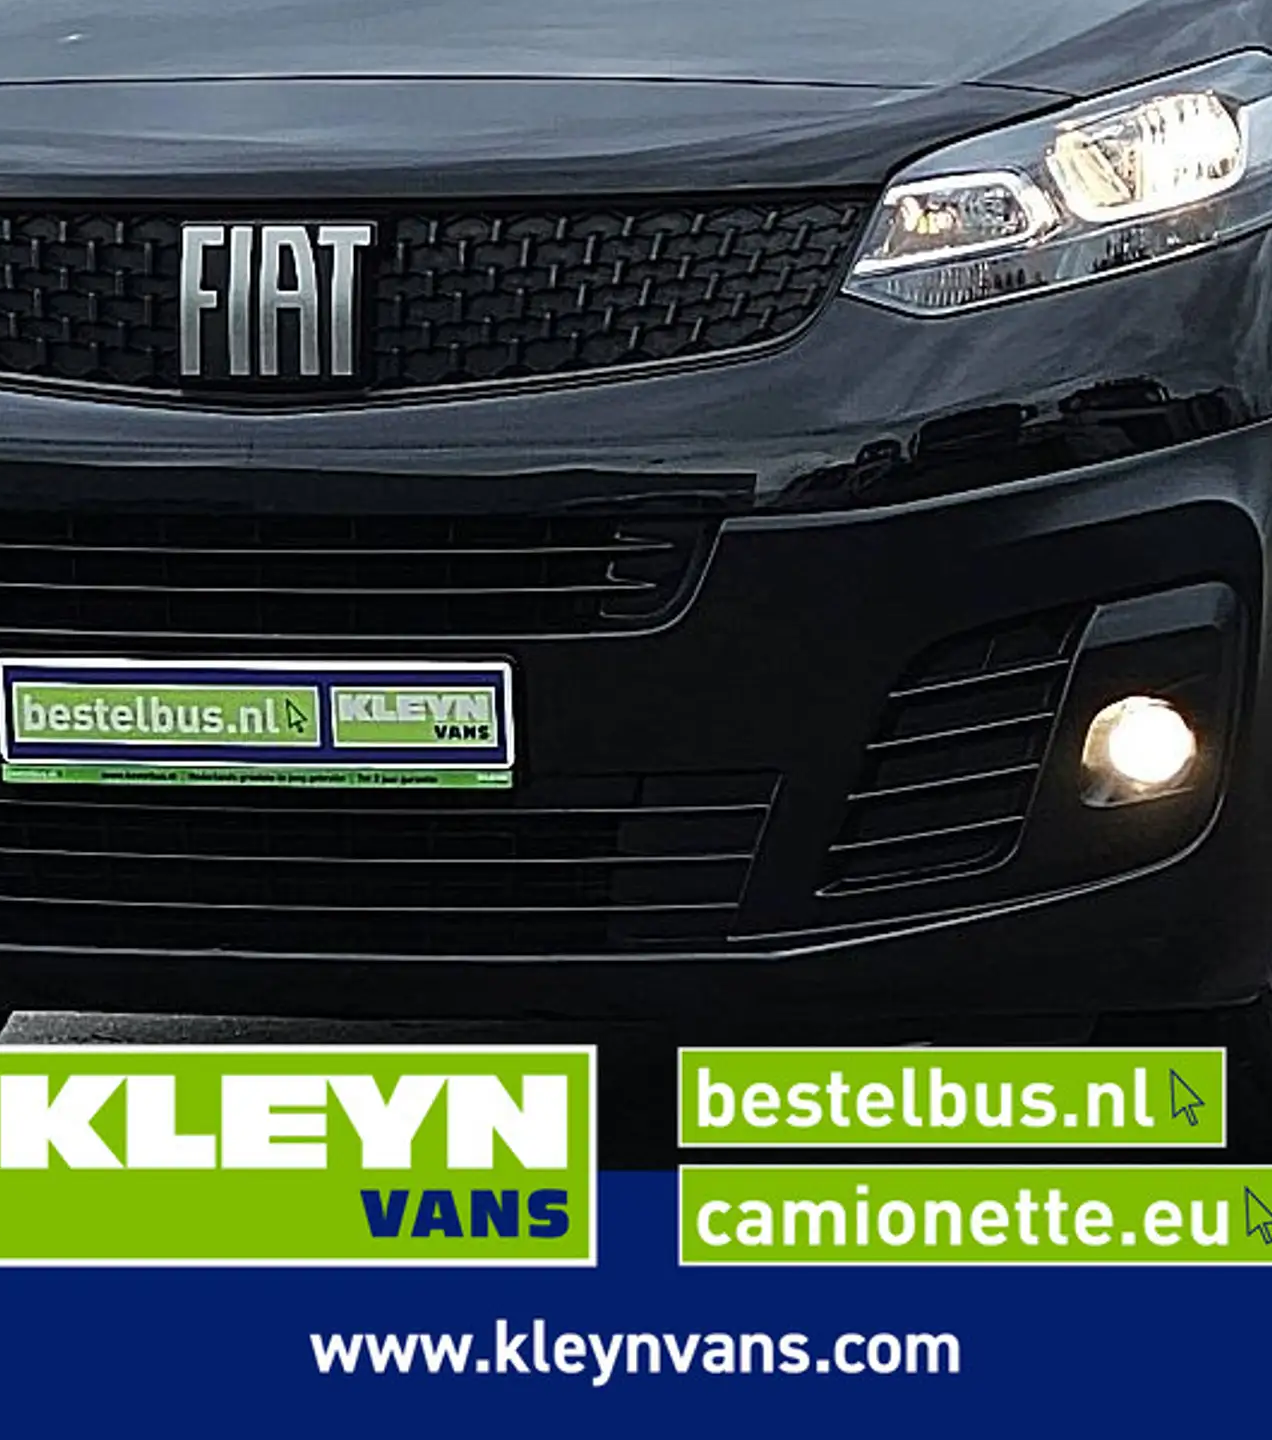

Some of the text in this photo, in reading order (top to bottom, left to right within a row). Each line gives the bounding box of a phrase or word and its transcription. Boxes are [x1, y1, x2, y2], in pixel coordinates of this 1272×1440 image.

[180, 225, 372, 376] FIAT
[23, 694, 280, 734] bestelbus.nl
[338, 693, 489, 722] KLEYN
[434, 725, 489, 740] VANS
